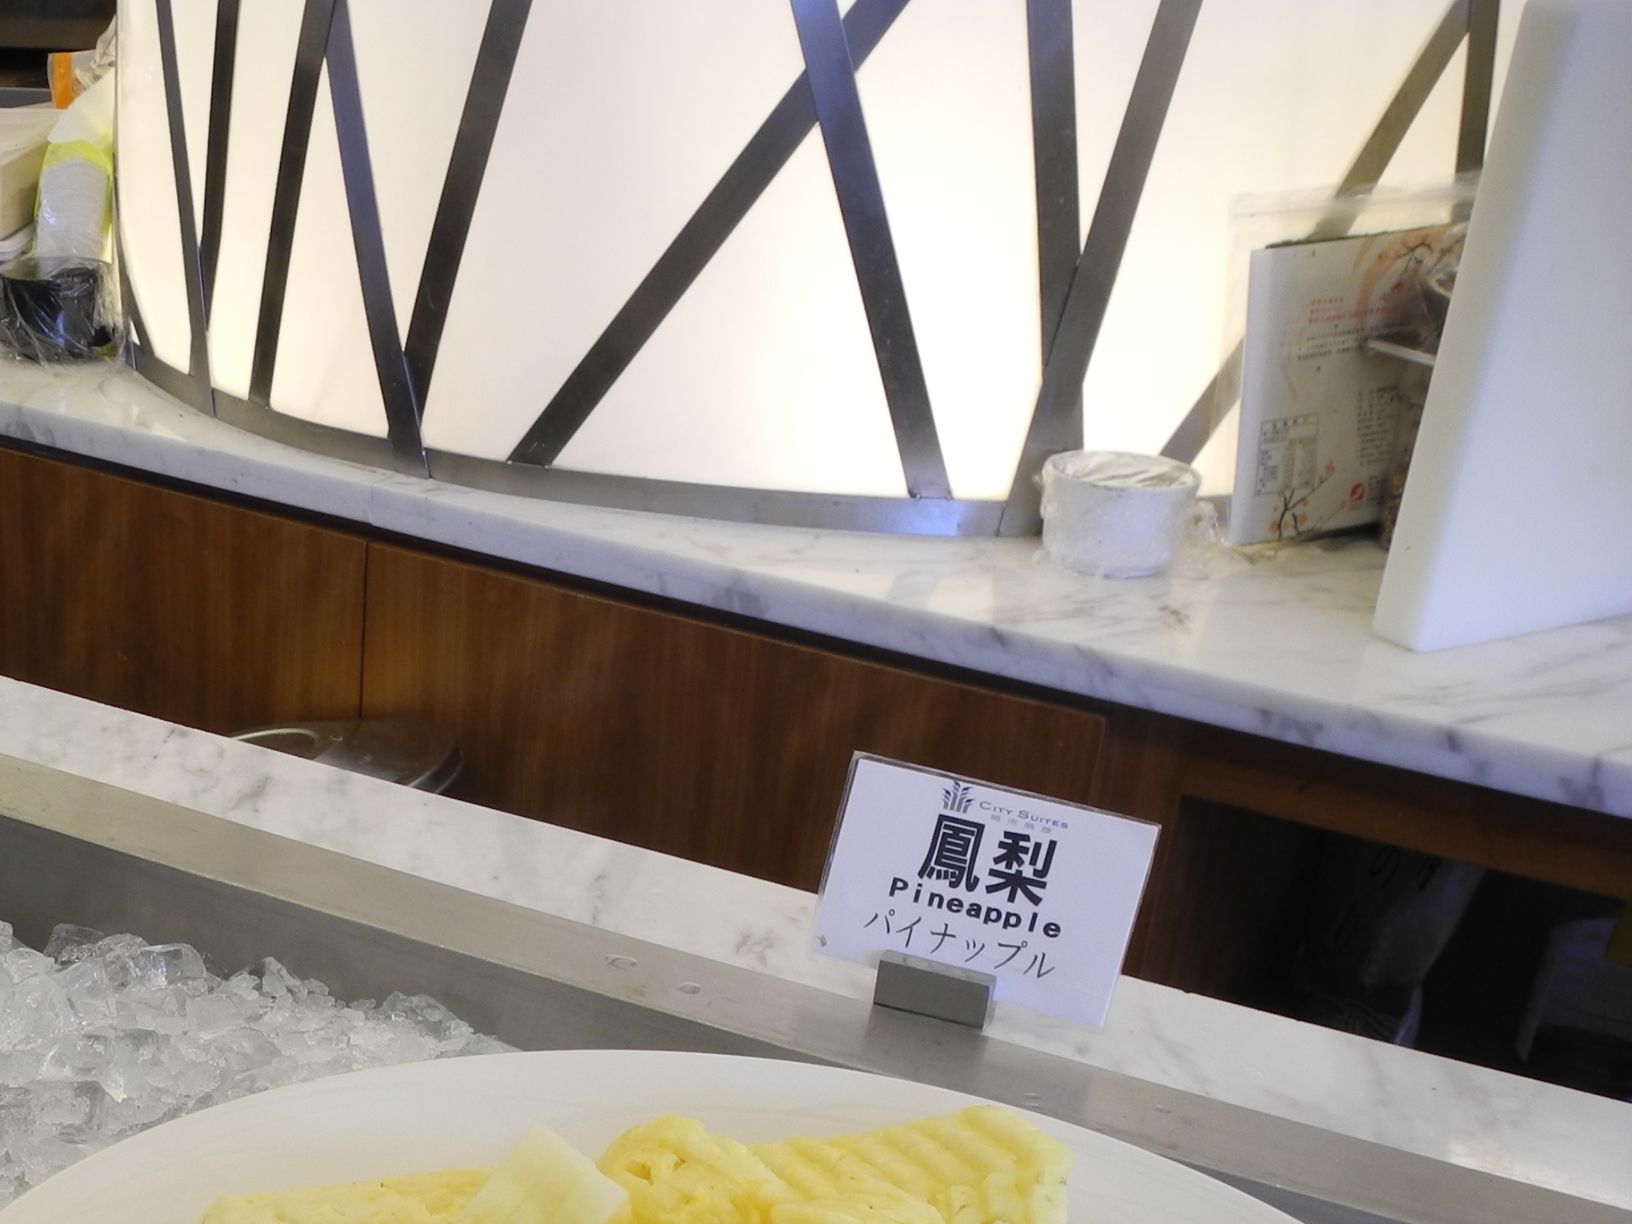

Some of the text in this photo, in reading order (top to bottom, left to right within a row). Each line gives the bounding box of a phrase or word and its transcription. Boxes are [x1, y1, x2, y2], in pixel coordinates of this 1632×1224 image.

[917, 813, 1058, 906] 鳳梨
[863, 908, 1056, 980] パイナップル
[888, 877, 1062, 939] Pineapple
